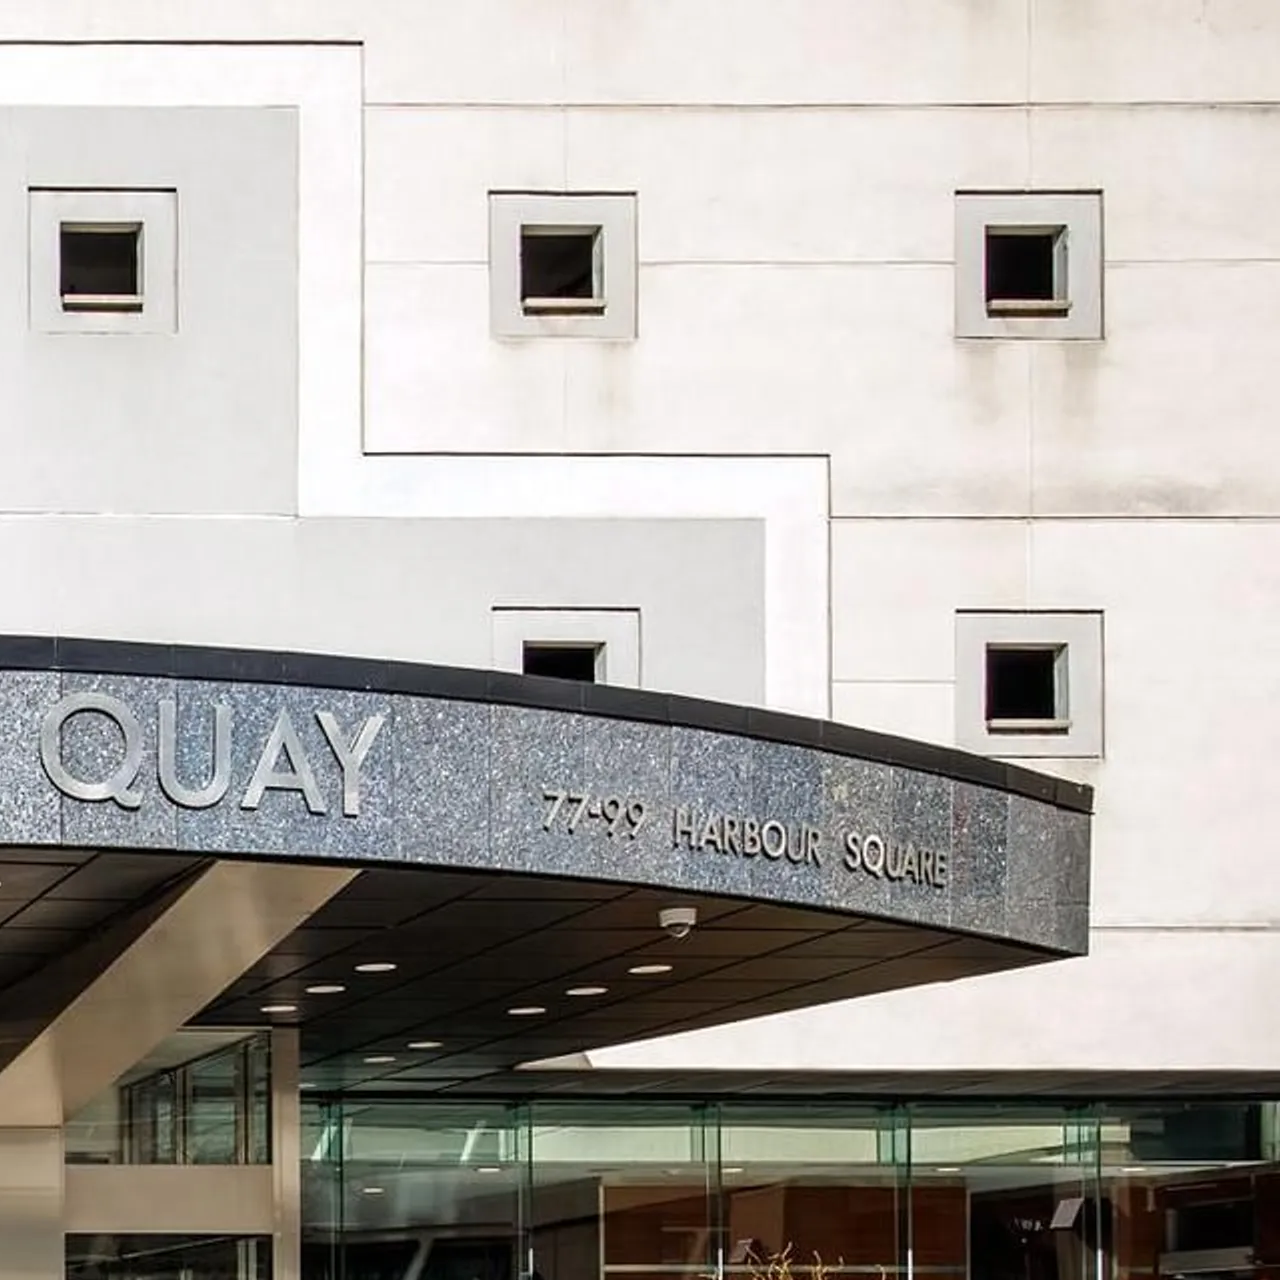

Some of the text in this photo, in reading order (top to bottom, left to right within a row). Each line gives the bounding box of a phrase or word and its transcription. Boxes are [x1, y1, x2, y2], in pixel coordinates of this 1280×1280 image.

[39, 690, 387, 817] QUAY
[543, 791, 947, 888] 77-99 HARBOUR SQUARE
